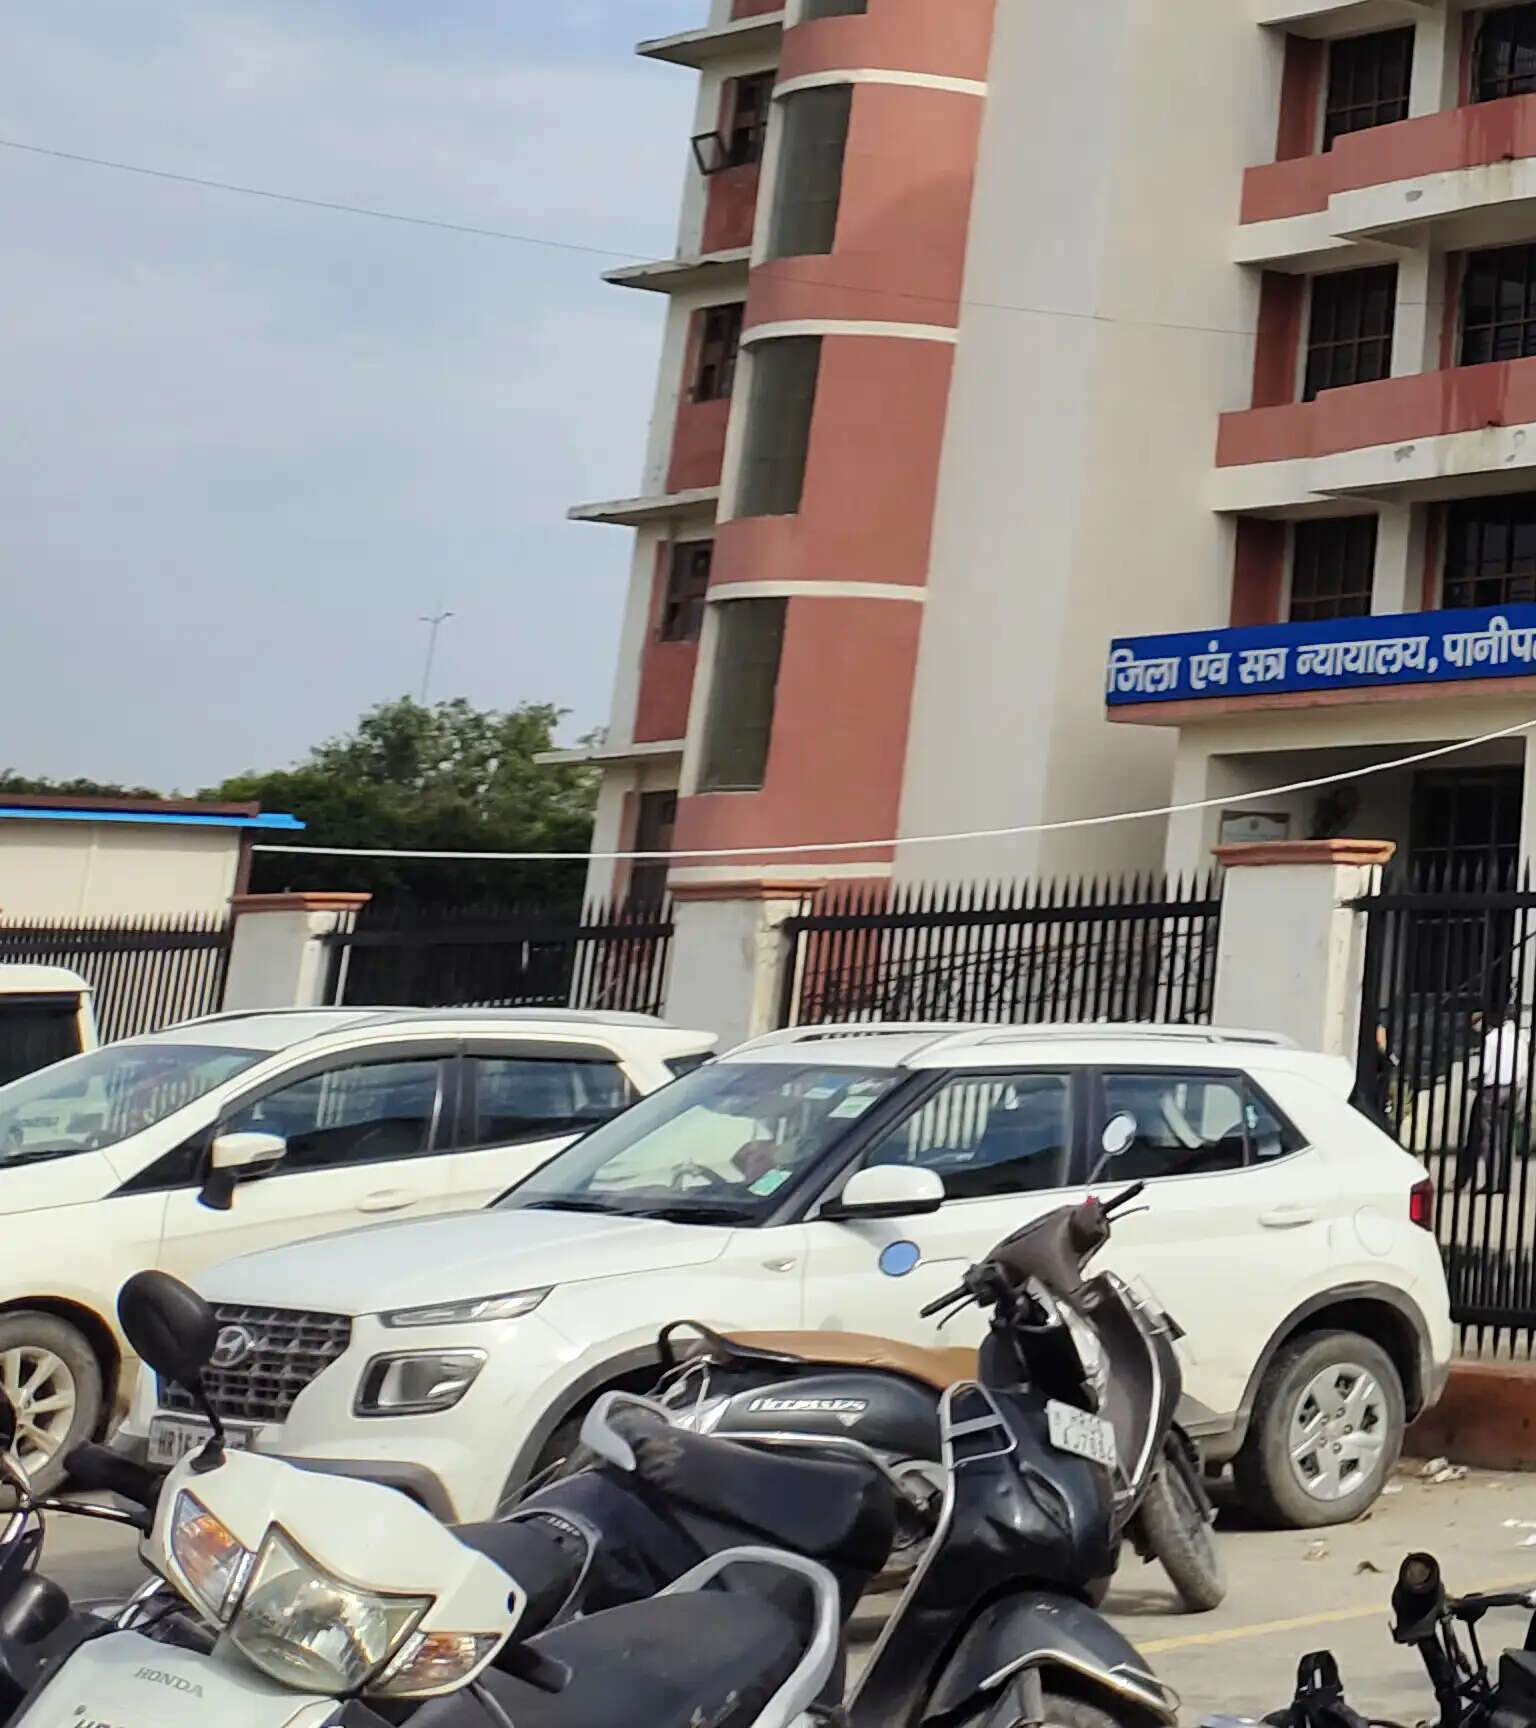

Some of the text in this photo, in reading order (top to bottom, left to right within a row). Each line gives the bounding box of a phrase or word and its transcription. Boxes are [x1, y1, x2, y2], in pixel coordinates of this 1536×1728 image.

[1106, 648, 1181, 693] जिला
[1238, 647, 1289, 684] सत्र
[1296, 636, 1439, 674] न्यायालय,
[133, 1666, 204, 1699] HONDA
